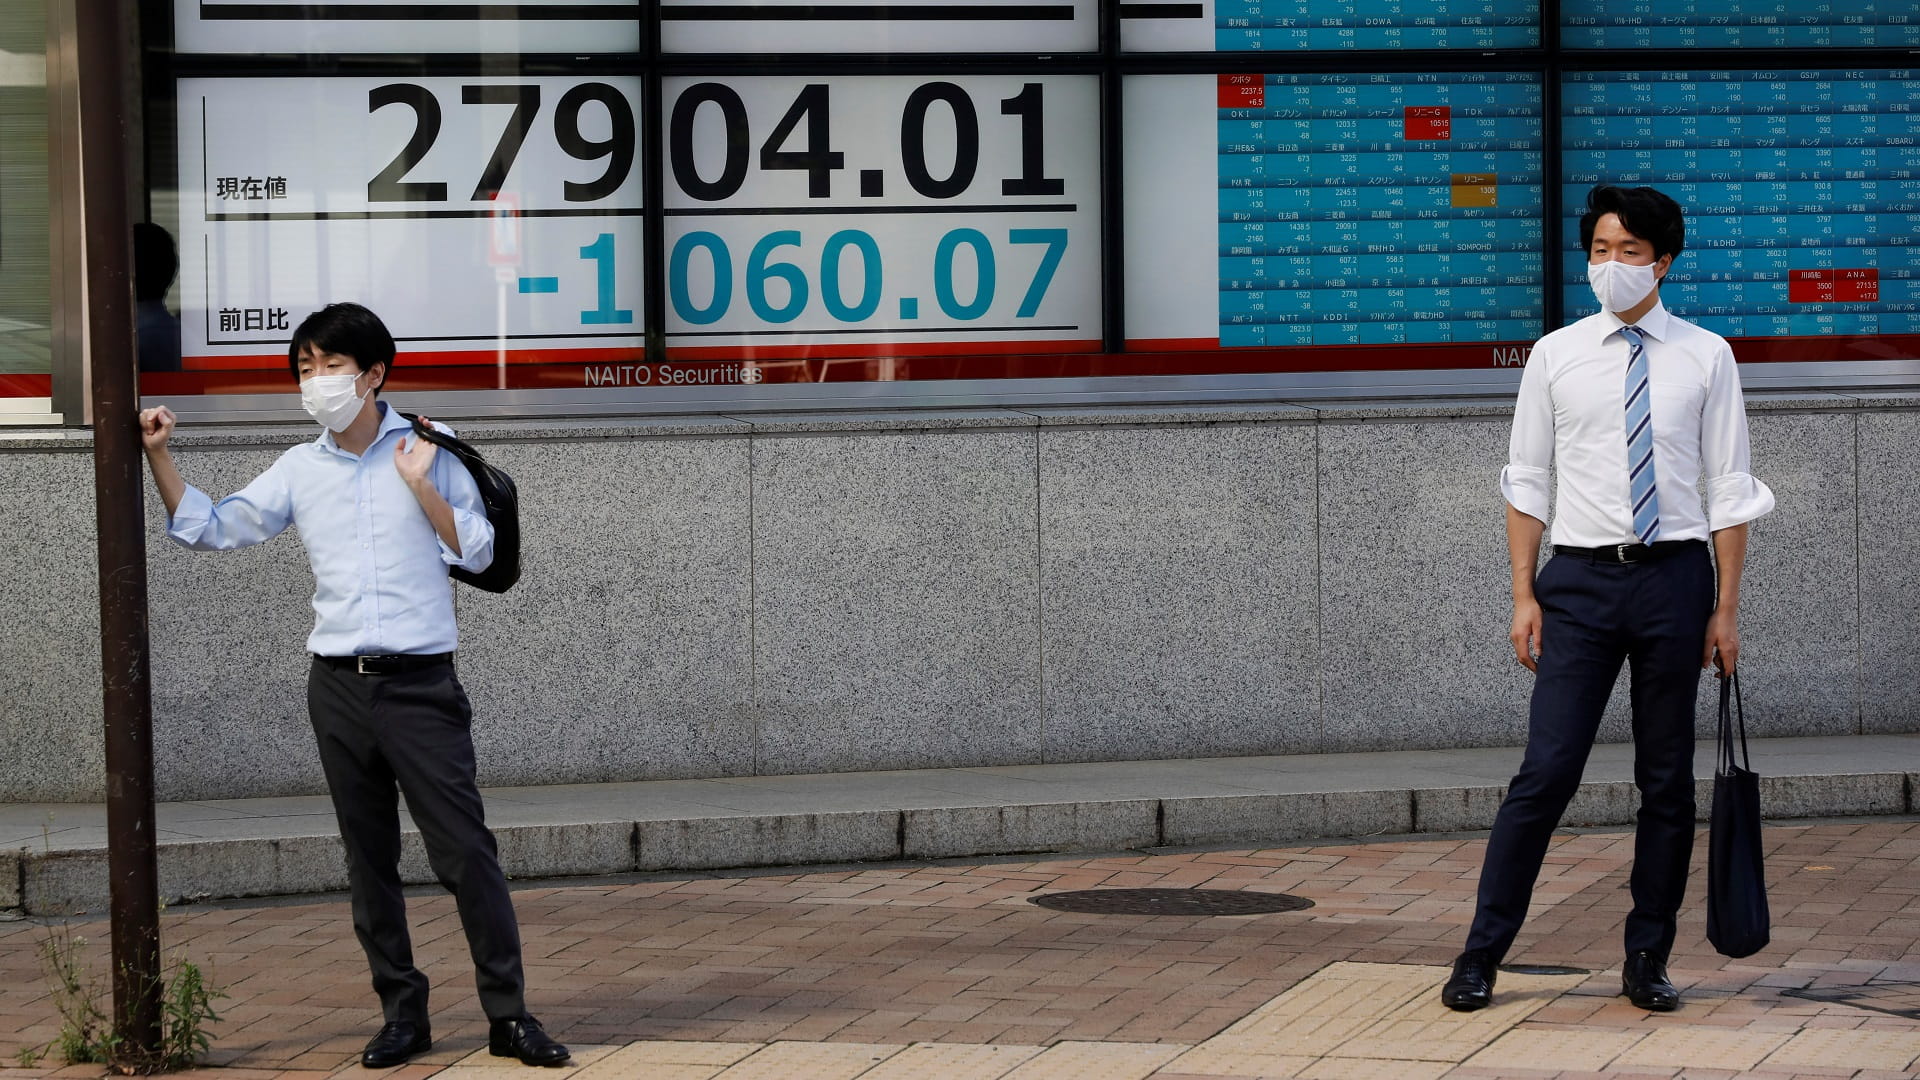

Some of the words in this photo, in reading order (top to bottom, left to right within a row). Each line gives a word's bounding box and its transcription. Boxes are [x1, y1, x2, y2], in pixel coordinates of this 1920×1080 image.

[367, 82, 1064, 202] 27904.01
[216, 176, 287, 200] 現在値
[519, 228, 1069, 325] -1060.07
[219, 307, 289, 332] 前日比
[584, 366, 651, 386] NAITO
[658, 364, 763, 384] Securities
